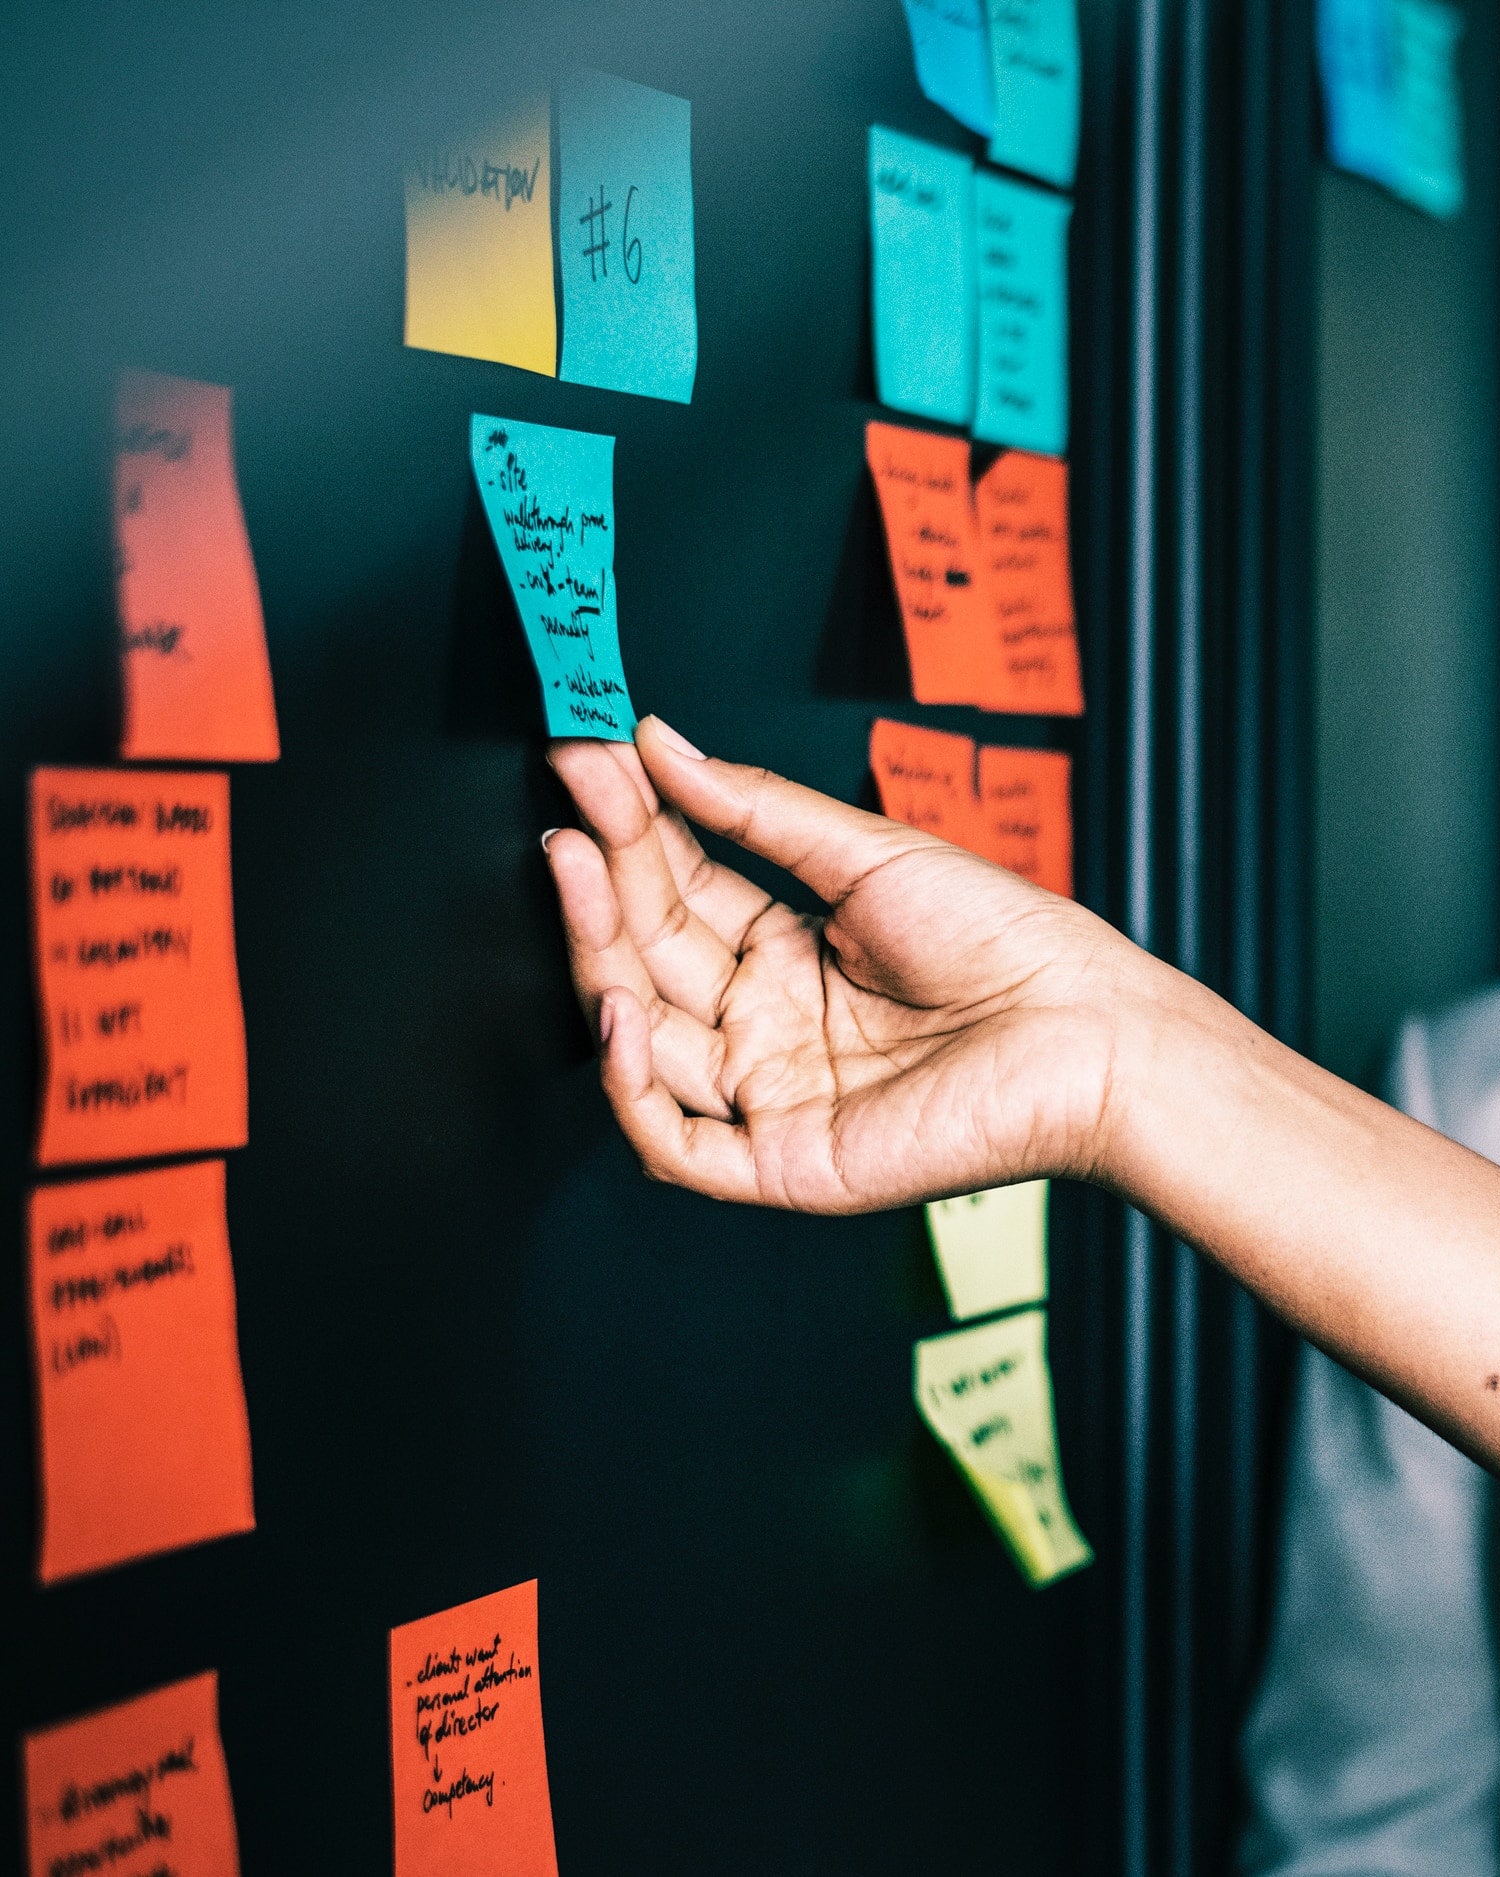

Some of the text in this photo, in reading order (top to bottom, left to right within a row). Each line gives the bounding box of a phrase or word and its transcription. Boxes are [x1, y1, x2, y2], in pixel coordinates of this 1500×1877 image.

[580, 185, 642, 284] #6
[417, 1632, 501, 1683] clients want
[474, 1650, 532, 1693] attention
[435, 1697, 500, 1743] director
